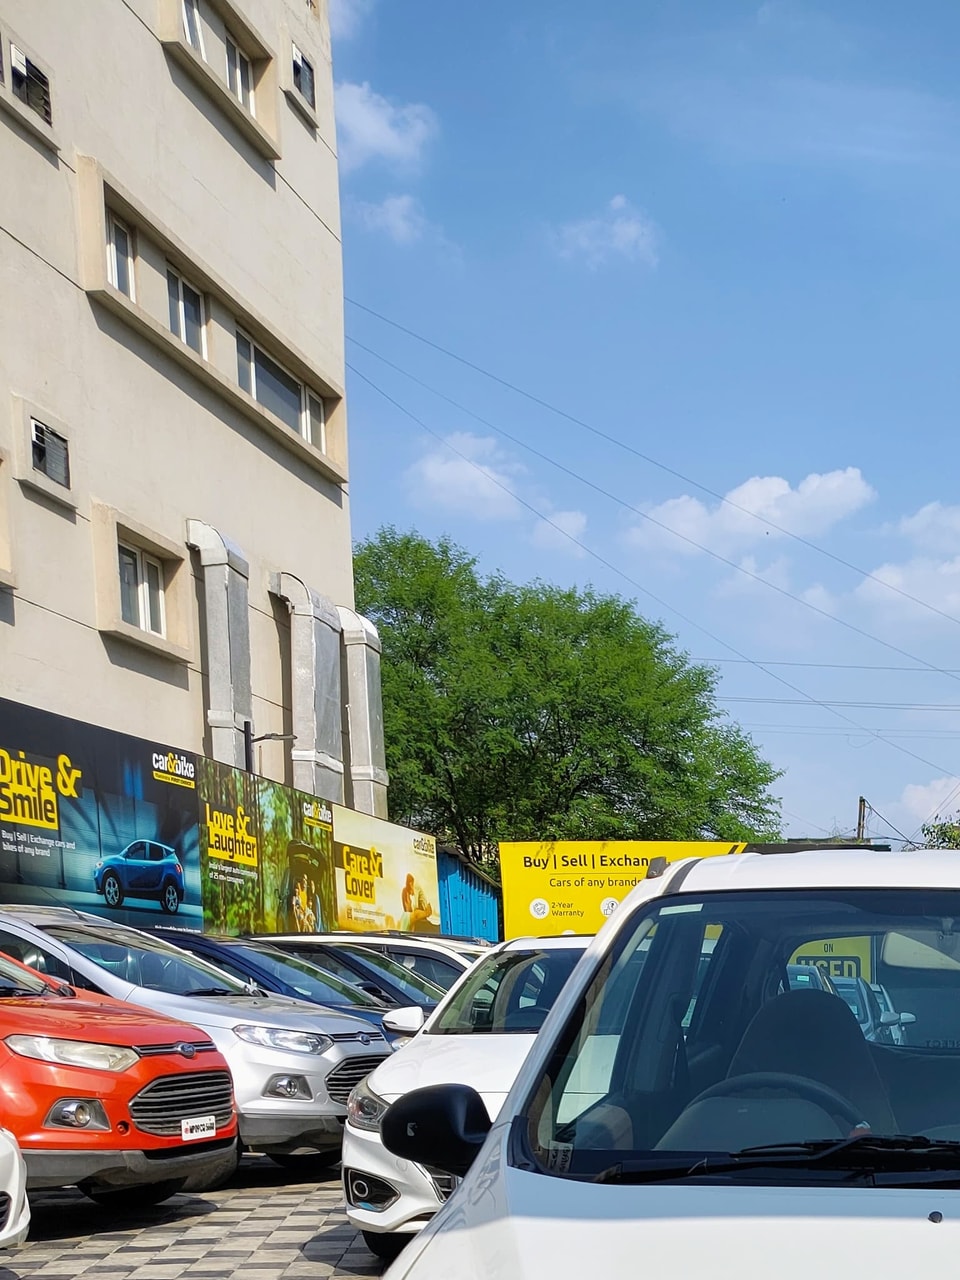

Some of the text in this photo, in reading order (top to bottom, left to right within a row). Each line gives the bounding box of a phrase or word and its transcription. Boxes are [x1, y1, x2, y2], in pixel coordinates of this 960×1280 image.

[0, 748, 82, 798] Drive &
[0, 782, 55, 823] Smile
[206, 803, 250, 834] Love &
[208, 828, 255, 859] Laughter
[343, 846, 383, 877] Care &
[523, 856, 549, 868] Buy
[561, 855, 587, 867] Sell
[600, 855, 648, 867] Exchan
[346, 871, 373, 898] Cover
[550, 878, 571, 887] Cars
[574, 877, 585, 887] of
[587, 879, 604, 888] any
[824, 943, 833, 953] ON
